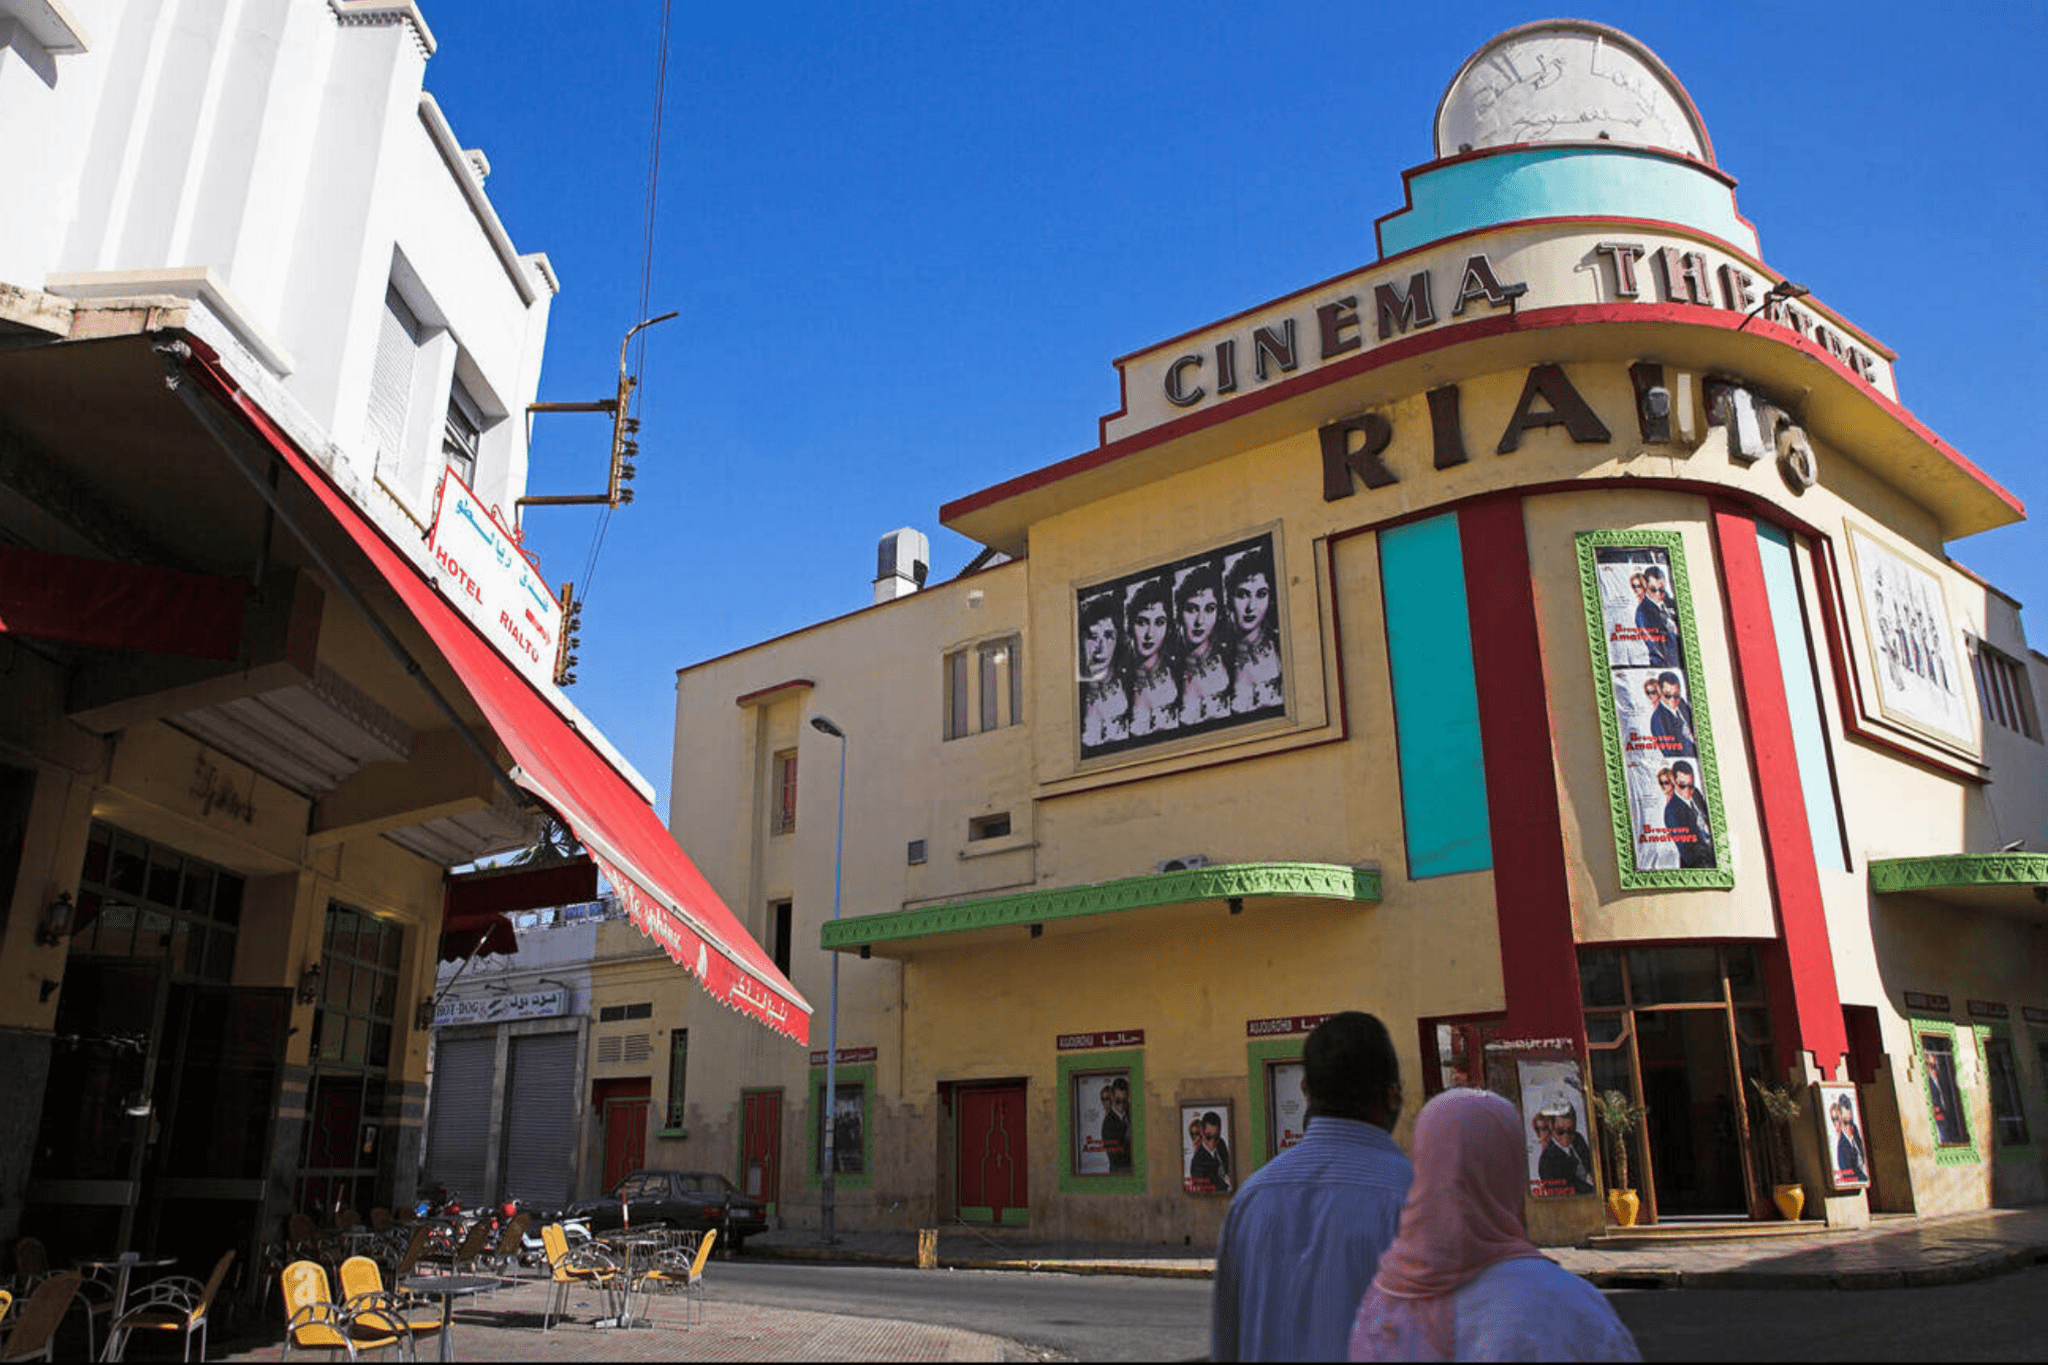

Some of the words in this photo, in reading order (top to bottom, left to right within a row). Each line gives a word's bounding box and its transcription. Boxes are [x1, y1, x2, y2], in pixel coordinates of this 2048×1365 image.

[1164, 253, 1508, 407] CINEMA
[436, 545, 483, 606] HOTEL
[499, 609, 540, 664] RIALTO
[1610, 632, 1667, 643] Amateurs
[1625, 741, 1683, 751] Amateurs
[1639, 833, 1698, 844] Amateurs
